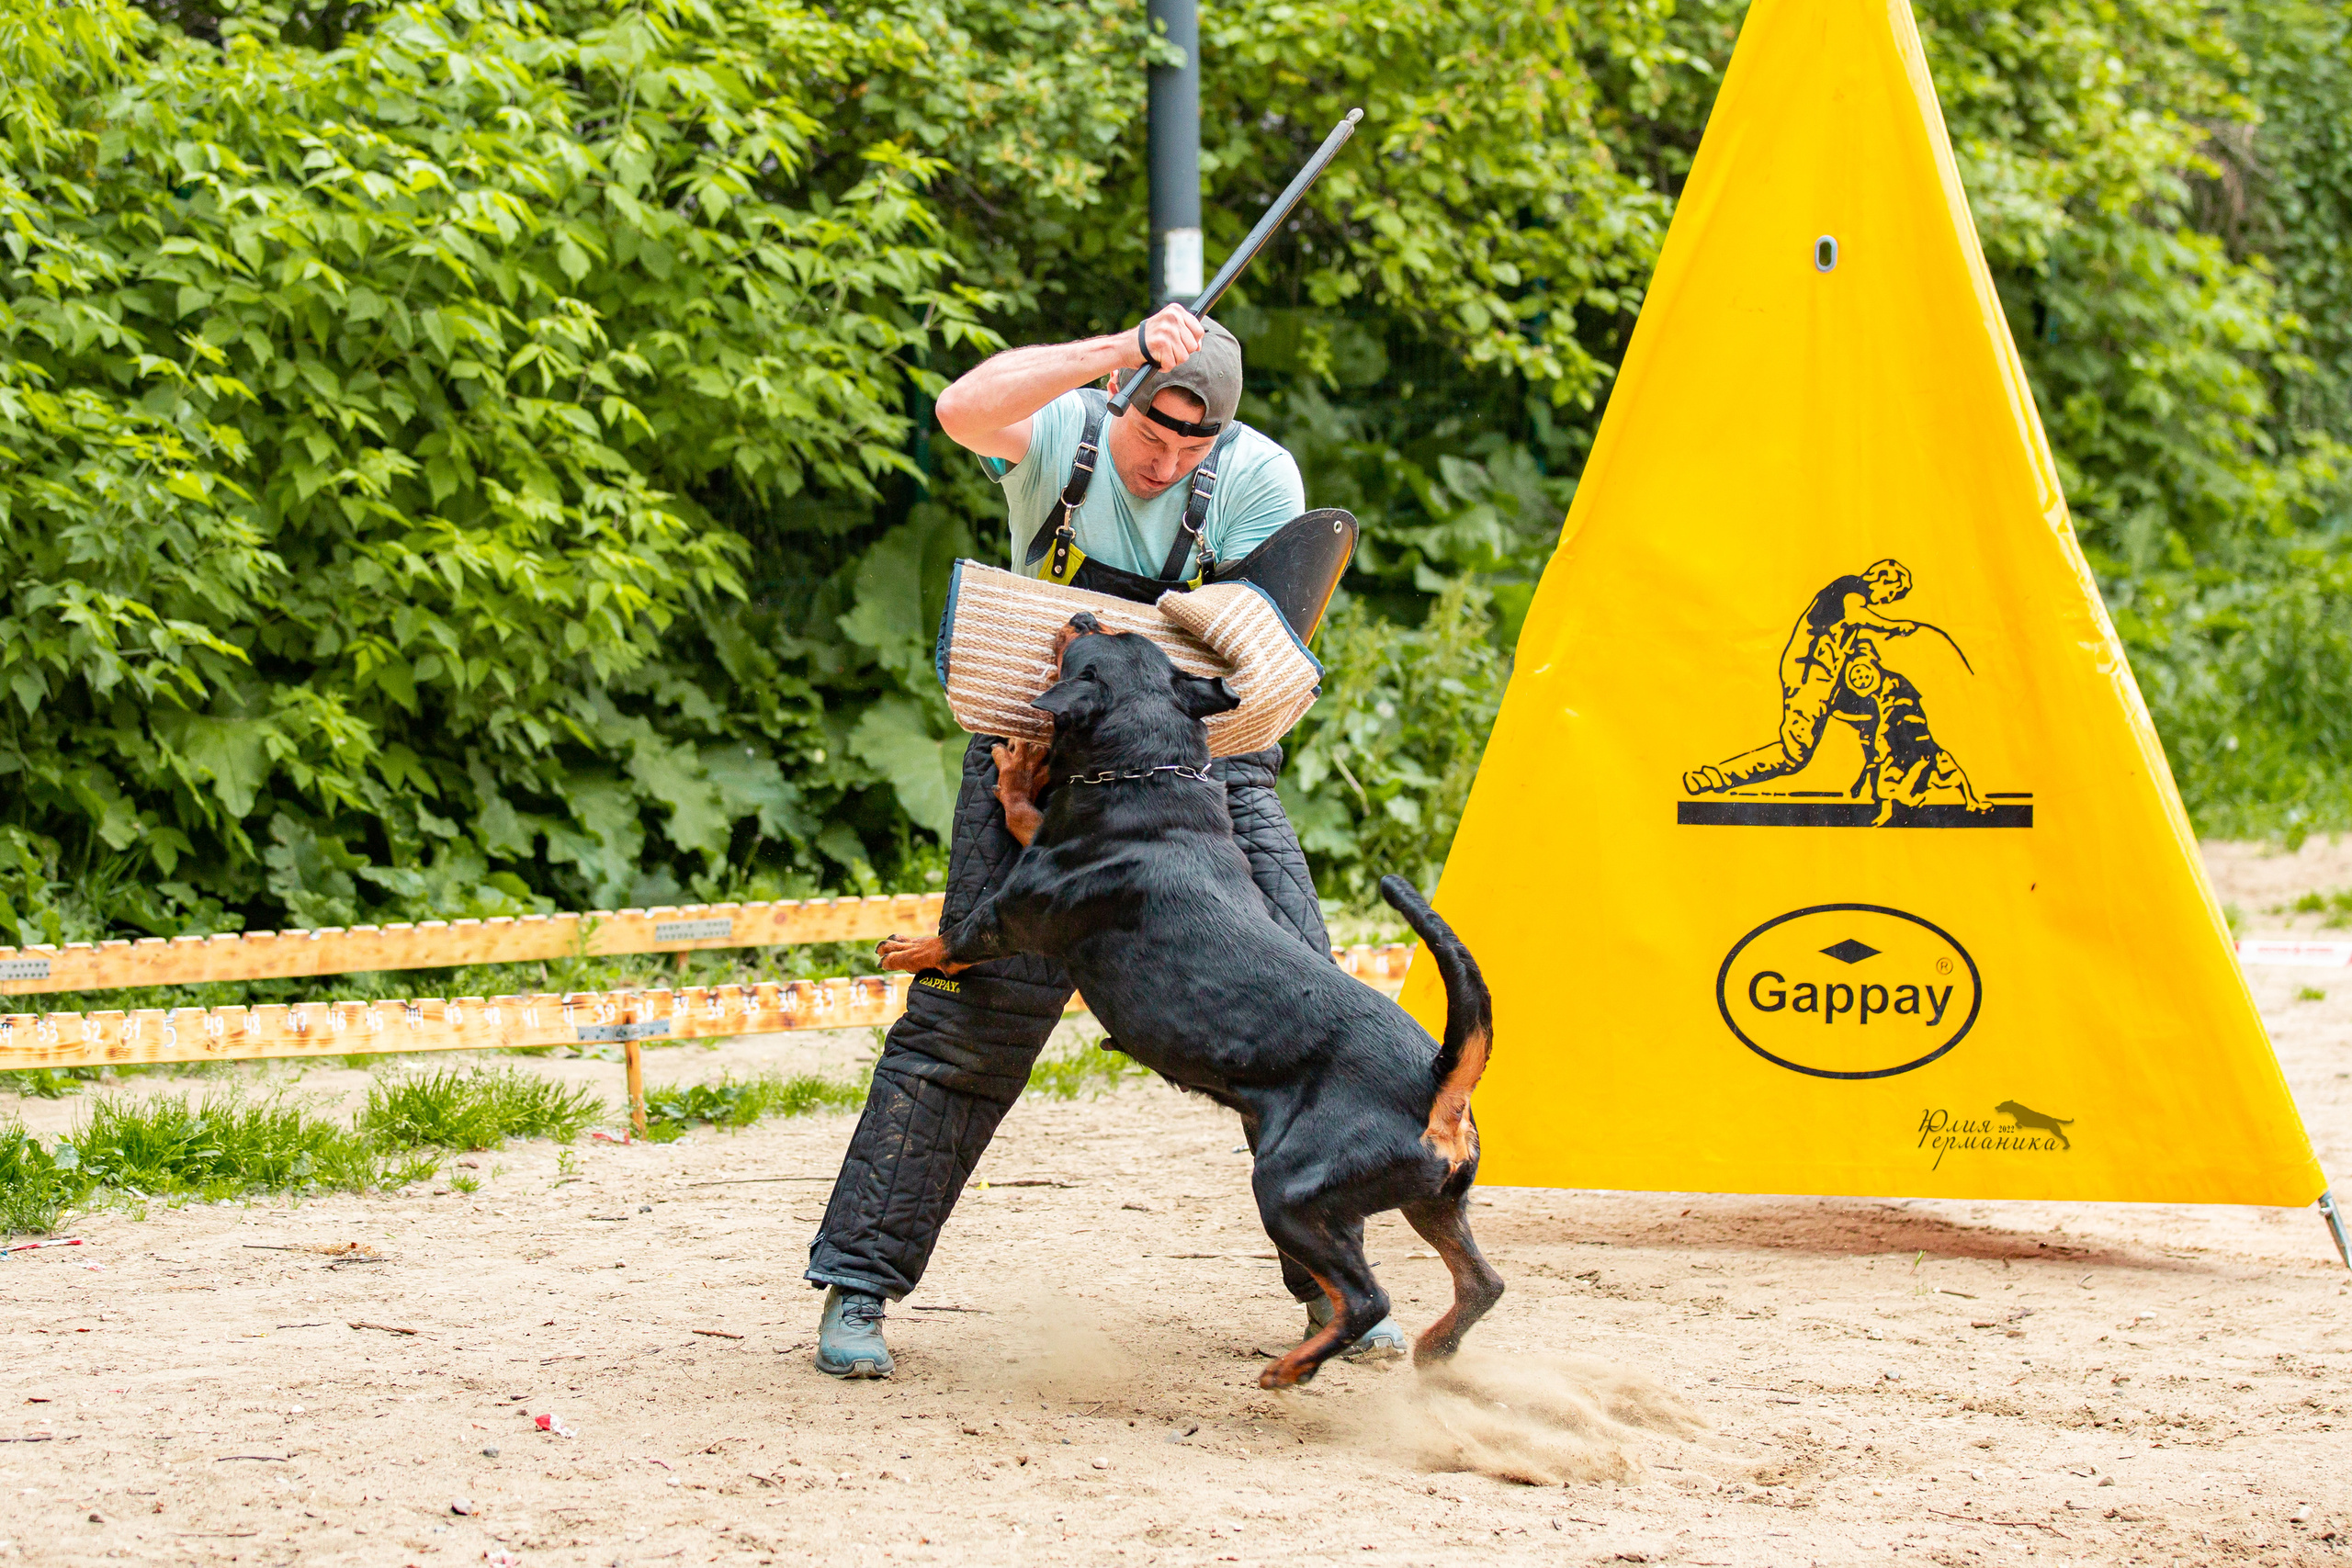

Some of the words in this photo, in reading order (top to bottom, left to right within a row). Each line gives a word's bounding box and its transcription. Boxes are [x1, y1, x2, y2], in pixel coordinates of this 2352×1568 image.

[37, 1021, 59, 1043] 53
[81, 1020, 103, 1043] 52
[122, 1018, 141, 1040] 51
[204, 1016, 224, 1037] 49
[243, 1014, 261, 1035] 48
[288, 1012, 307, 1032] 47
[326, 1010, 347, 1032] 46
[367, 1010, 384, 1032] 45
[405, 1008, 424, 1030] 44
[444, 1006, 463, 1025] 43
[483, 1006, 502, 1026] 42
[522, 1008, 539, 1028] 41
[593, 1003, 616, 1025] 39
[635, 999, 654, 1023] 38
[673, 996, 689, 1018] 37
[706, 998, 725, 1020] 36
[741, 996, 760, 1015] 35
[777, 990, 797, 1012] 34
[812, 987, 835, 1015] 33
[1748, 971, 1953, 1027] Gappay
